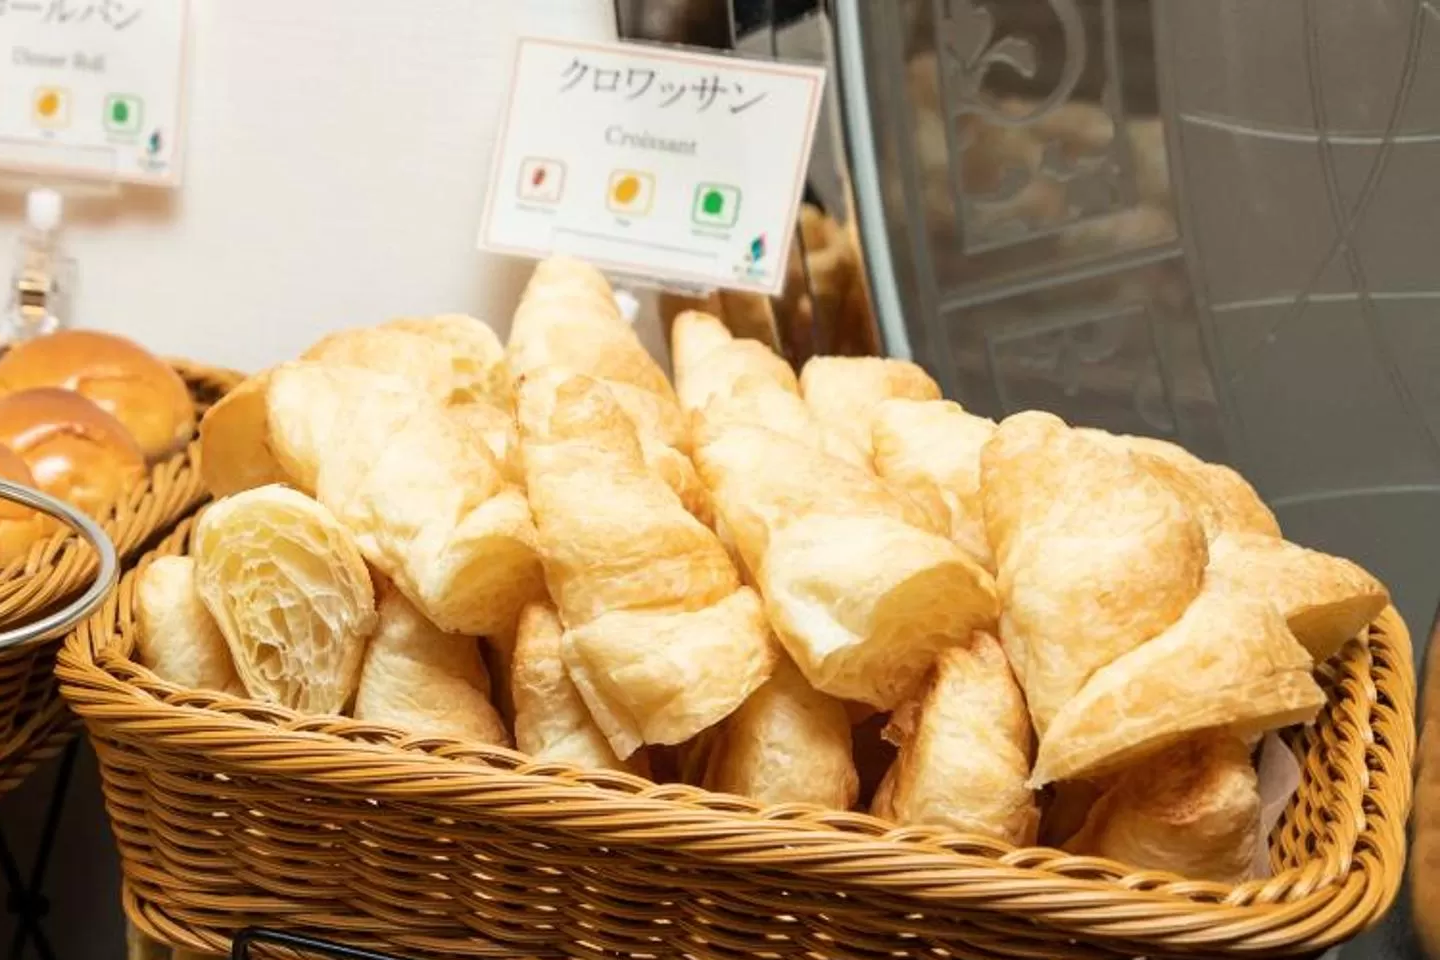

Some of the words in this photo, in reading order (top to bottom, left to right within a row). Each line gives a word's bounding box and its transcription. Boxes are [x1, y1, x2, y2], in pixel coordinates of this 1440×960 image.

[560, 56, 769, 115] クロワッサン
[604, 124, 698, 156] Croissant
